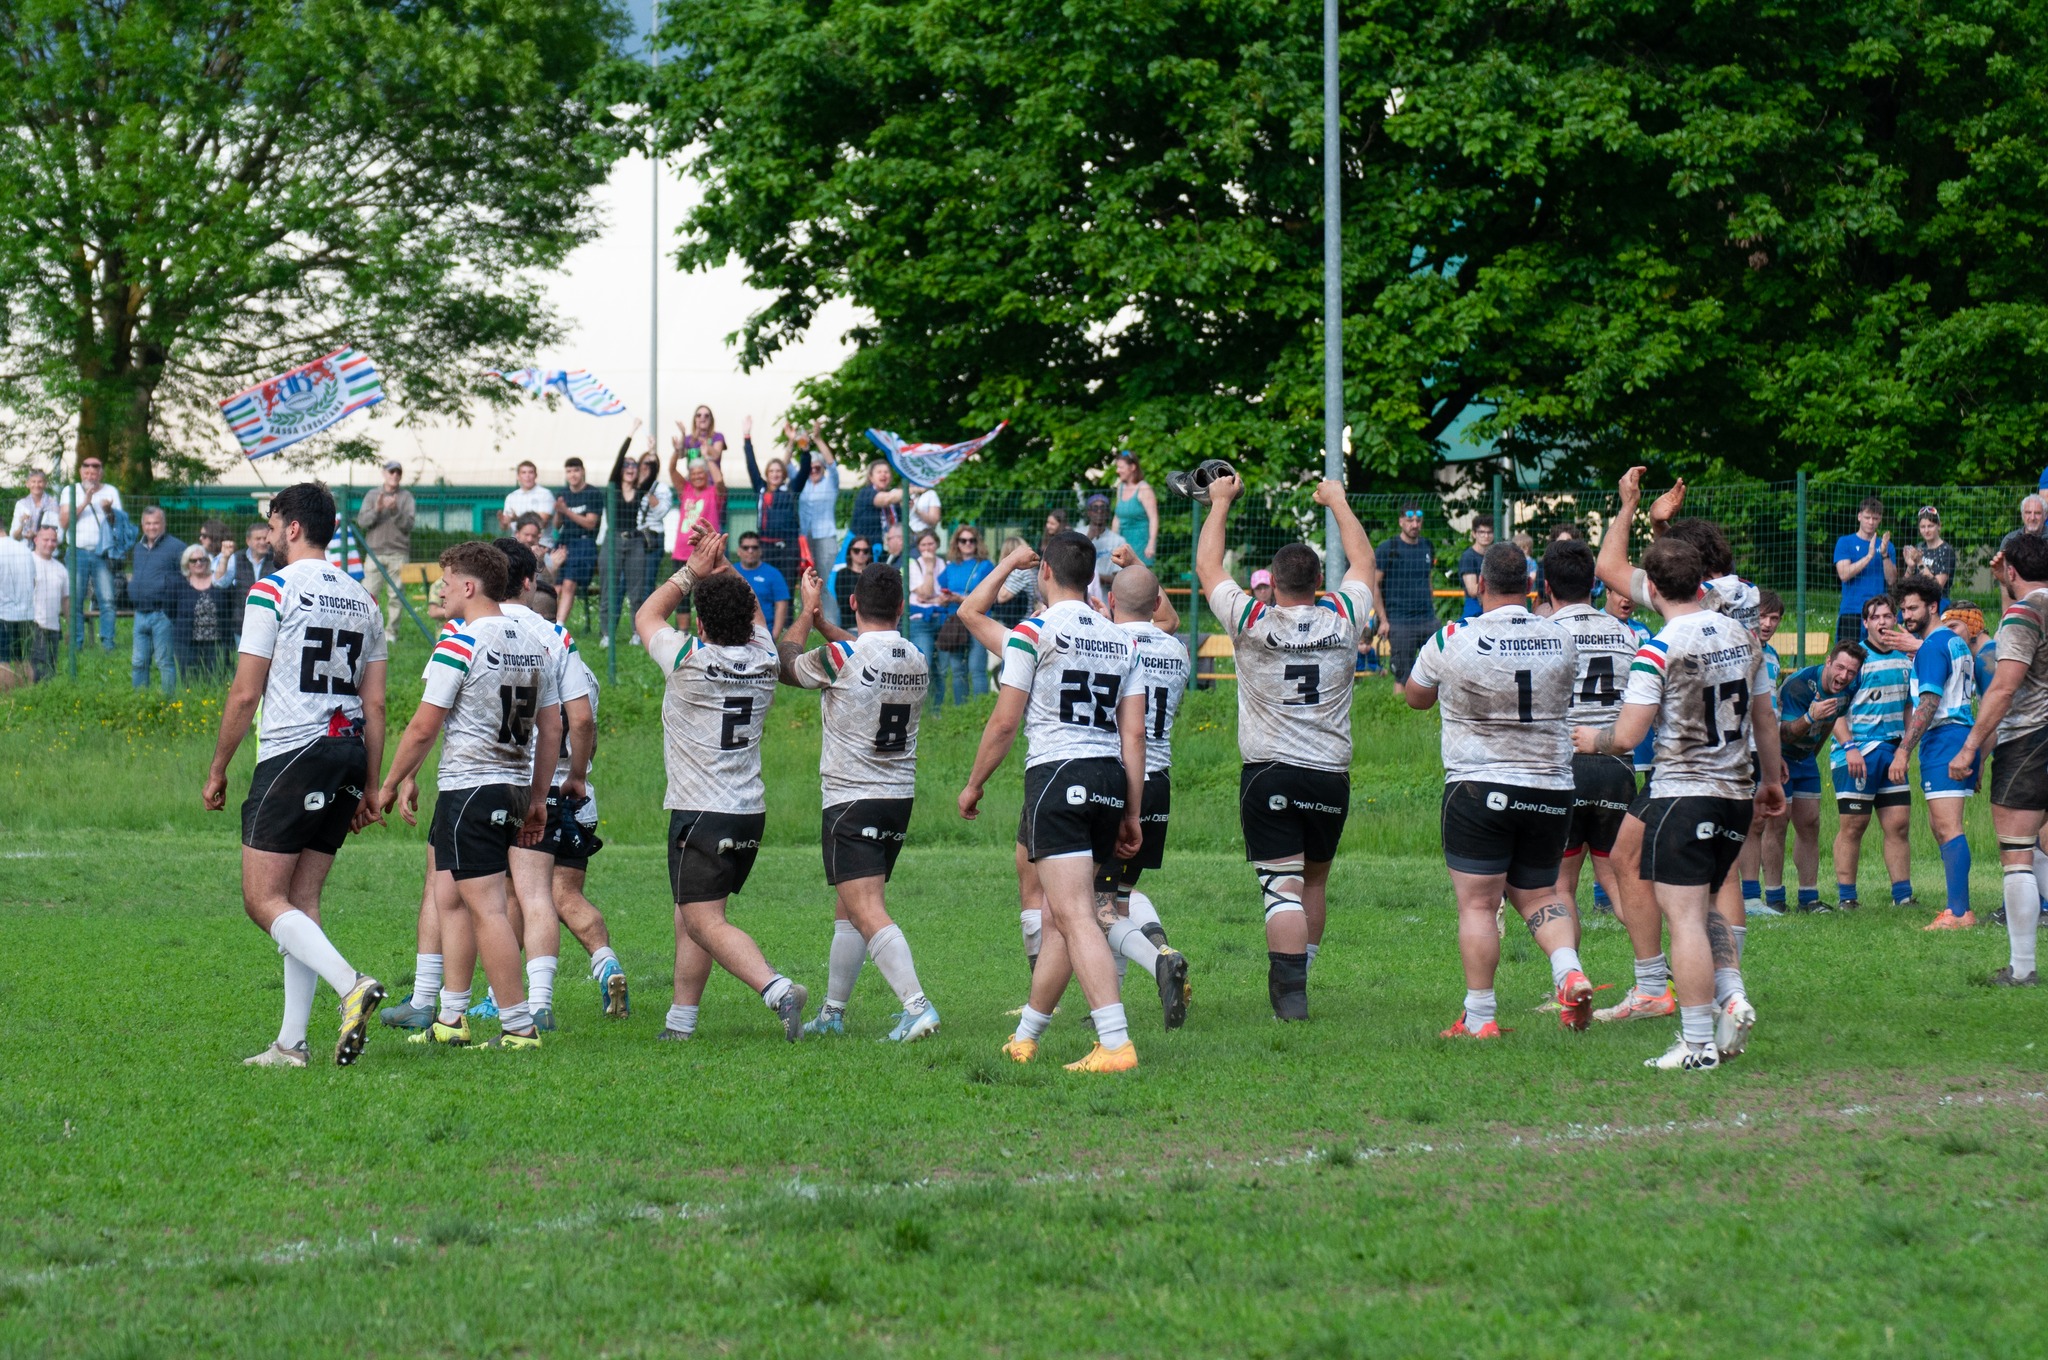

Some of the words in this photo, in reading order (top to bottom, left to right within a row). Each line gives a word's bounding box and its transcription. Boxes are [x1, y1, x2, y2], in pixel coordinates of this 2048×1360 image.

[318, 594, 370, 615] STOCCHETTI
[1074, 637, 1129, 656] STOCCHETTI
[1283, 632, 1342, 650] STOCCHETTI
[1499, 638, 1563, 651] STOCCHETTI
[1572, 634, 1626, 645] TOCCHETTI
[299, 626, 365, 697] 23
[502, 653, 545, 667] STOCCHETTI
[892, 648, 906, 658] BBR
[1701, 643, 1753, 666] STOCCHETTI
[1140, 656, 1183, 670] CCHETTI
[880, 671, 928, 686] STOCCHETT
[1282, 664, 1320, 705] 3
[1059, 669, 1122, 734] 22
[1514, 669, 1533, 723] 1
[498, 685, 538, 746] 12
[1702, 678, 1750, 748] 13
[720, 696, 754, 751] 2
[875, 703, 911, 753] 8
[1089, 792, 1111, 806] JOHN
[1315, 802, 1342, 814] DEERE
[1510, 800, 1538, 812] JOHN
[1538, 804, 1567, 816] DEERE
[1600, 799, 1629, 811] DEERE
